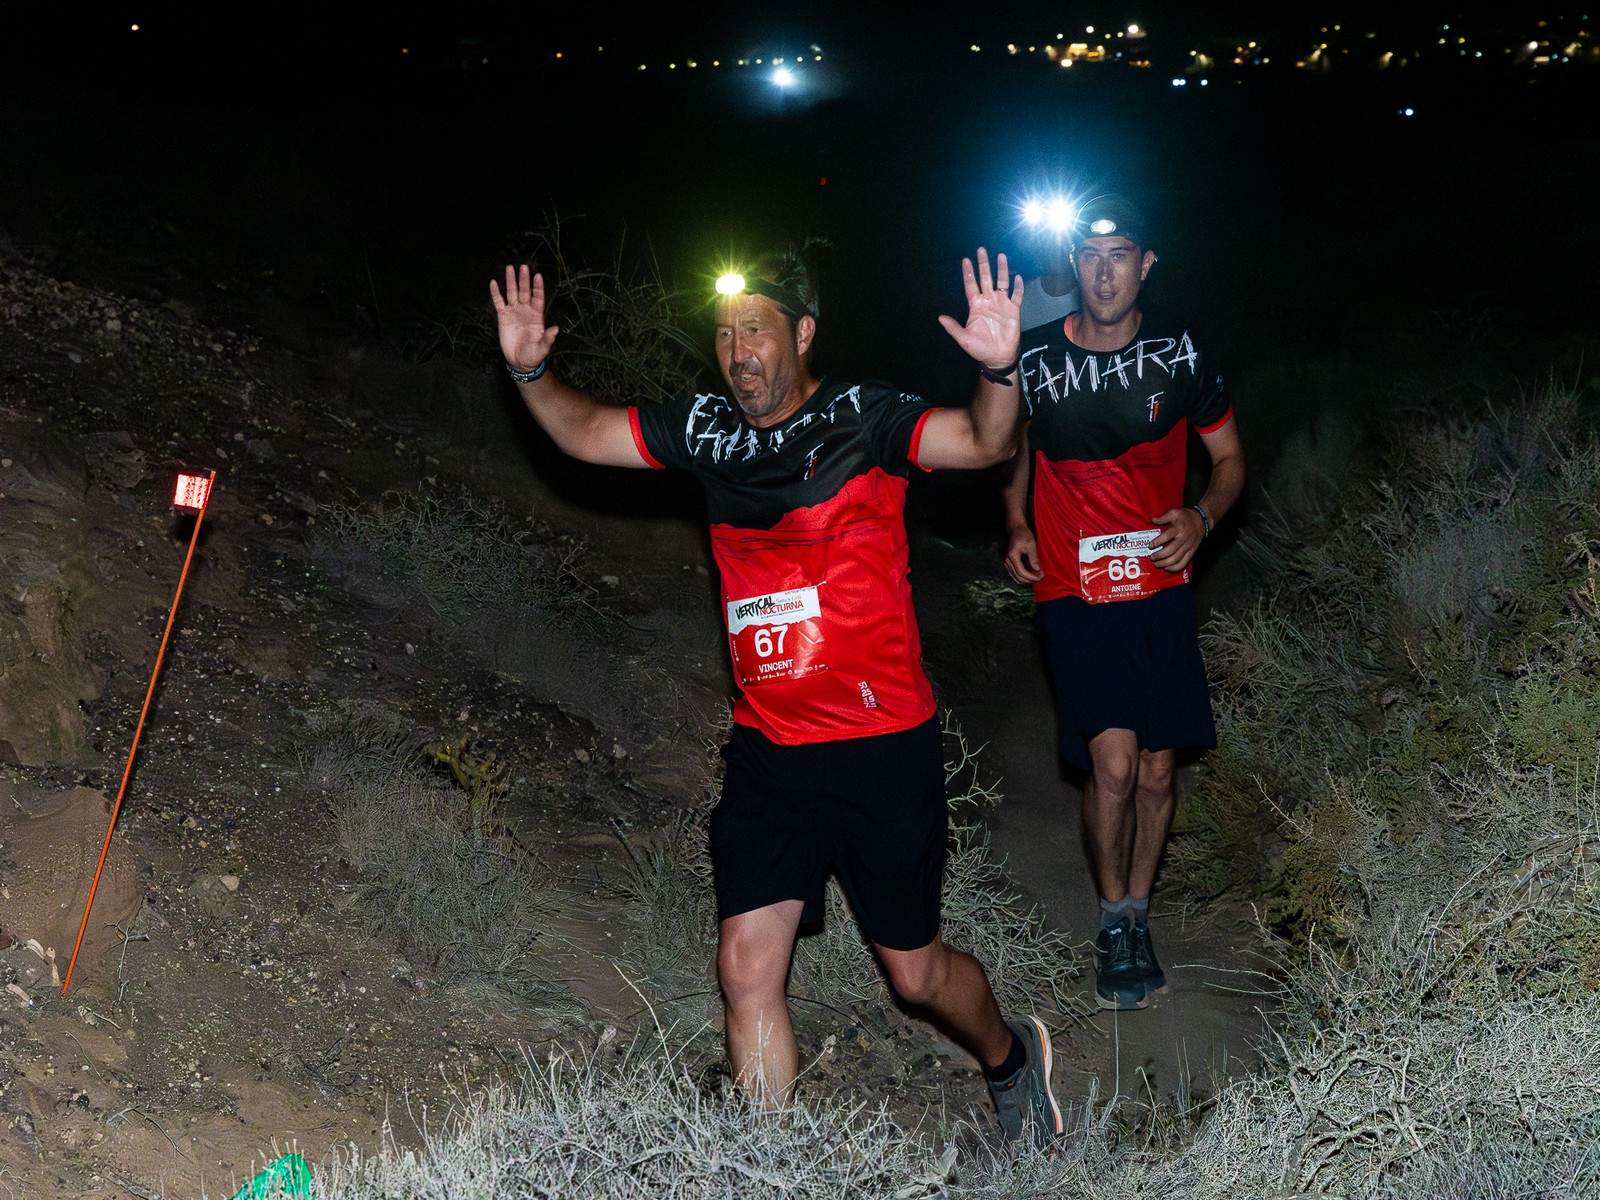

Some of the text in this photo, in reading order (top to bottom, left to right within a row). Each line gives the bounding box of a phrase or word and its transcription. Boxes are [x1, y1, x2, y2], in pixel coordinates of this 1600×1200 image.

[1018, 330, 1198, 417] FAMARA
[1091, 534, 1130, 552] VERTICAL
[1107, 557, 1141, 582] 66
[1111, 583, 1142, 593] ANTOINE
[735, 595, 776, 620] VERTICAL
[760, 600, 804, 618] NOCTURNA
[754, 625, 789, 658] 67
[758, 659, 794, 673] VINCENT
